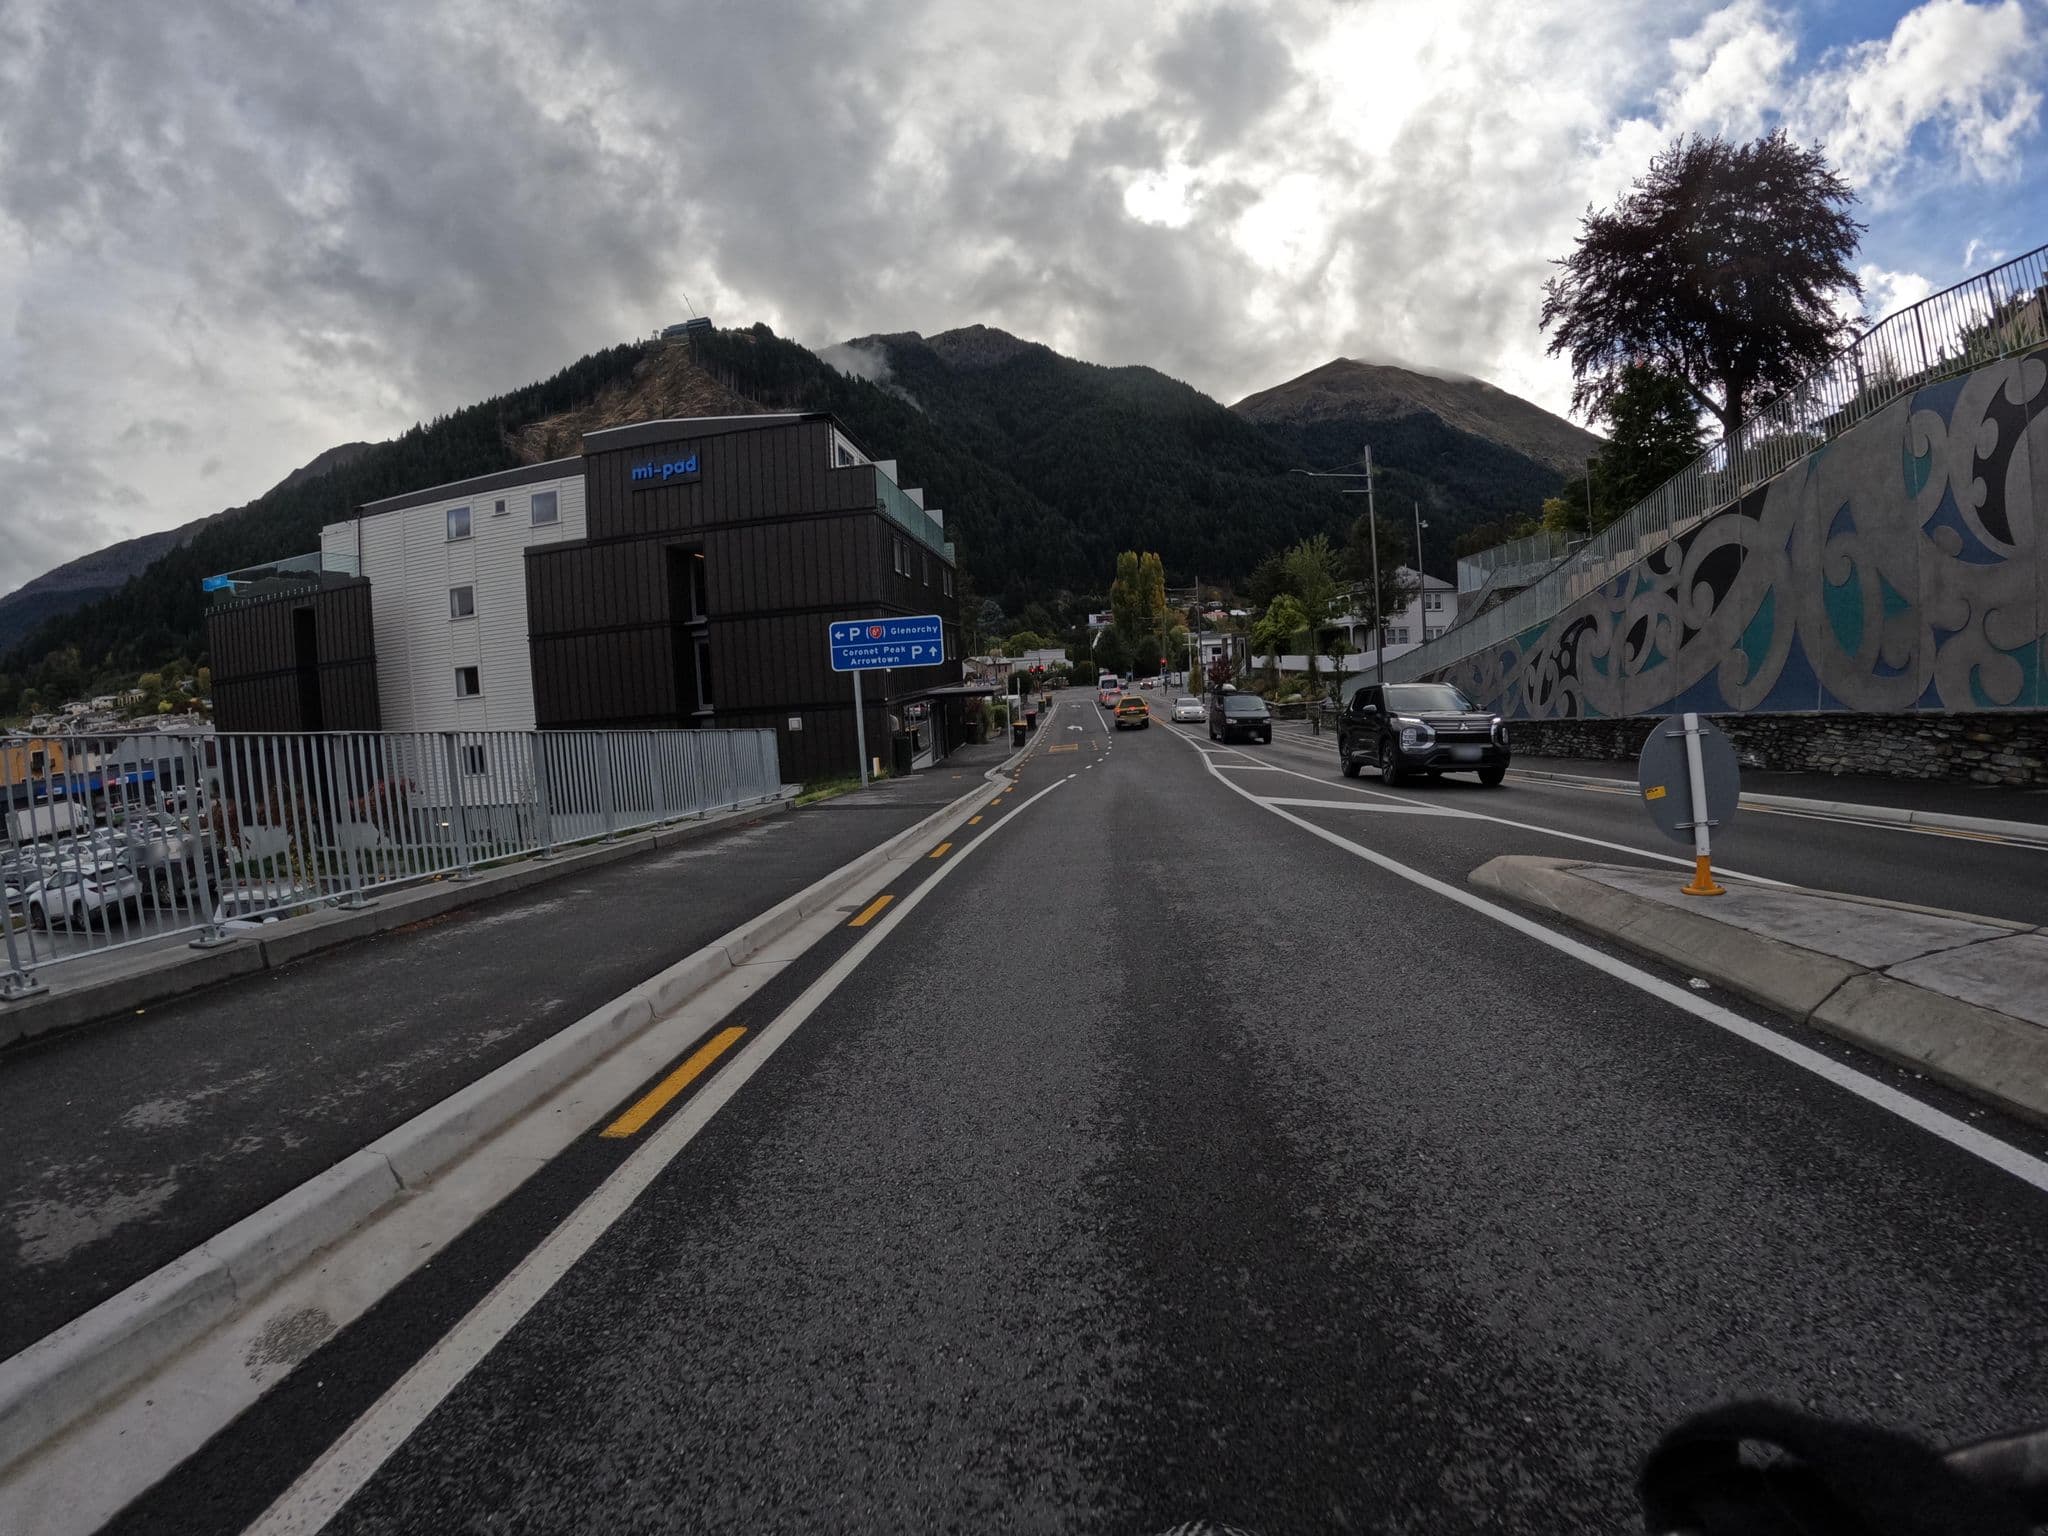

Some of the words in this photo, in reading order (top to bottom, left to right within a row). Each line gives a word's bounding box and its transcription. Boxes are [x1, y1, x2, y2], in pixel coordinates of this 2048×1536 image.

[631, 454, 698, 481] mi-pad
[849, 627, 861, 641] P
[890, 626, 938, 635] Glenorchy
[842, 647, 878, 657] Coronet
[884, 646, 906, 654] Peak
[911, 645, 923, 660] P
[851, 656, 900, 666] Arrowtown
